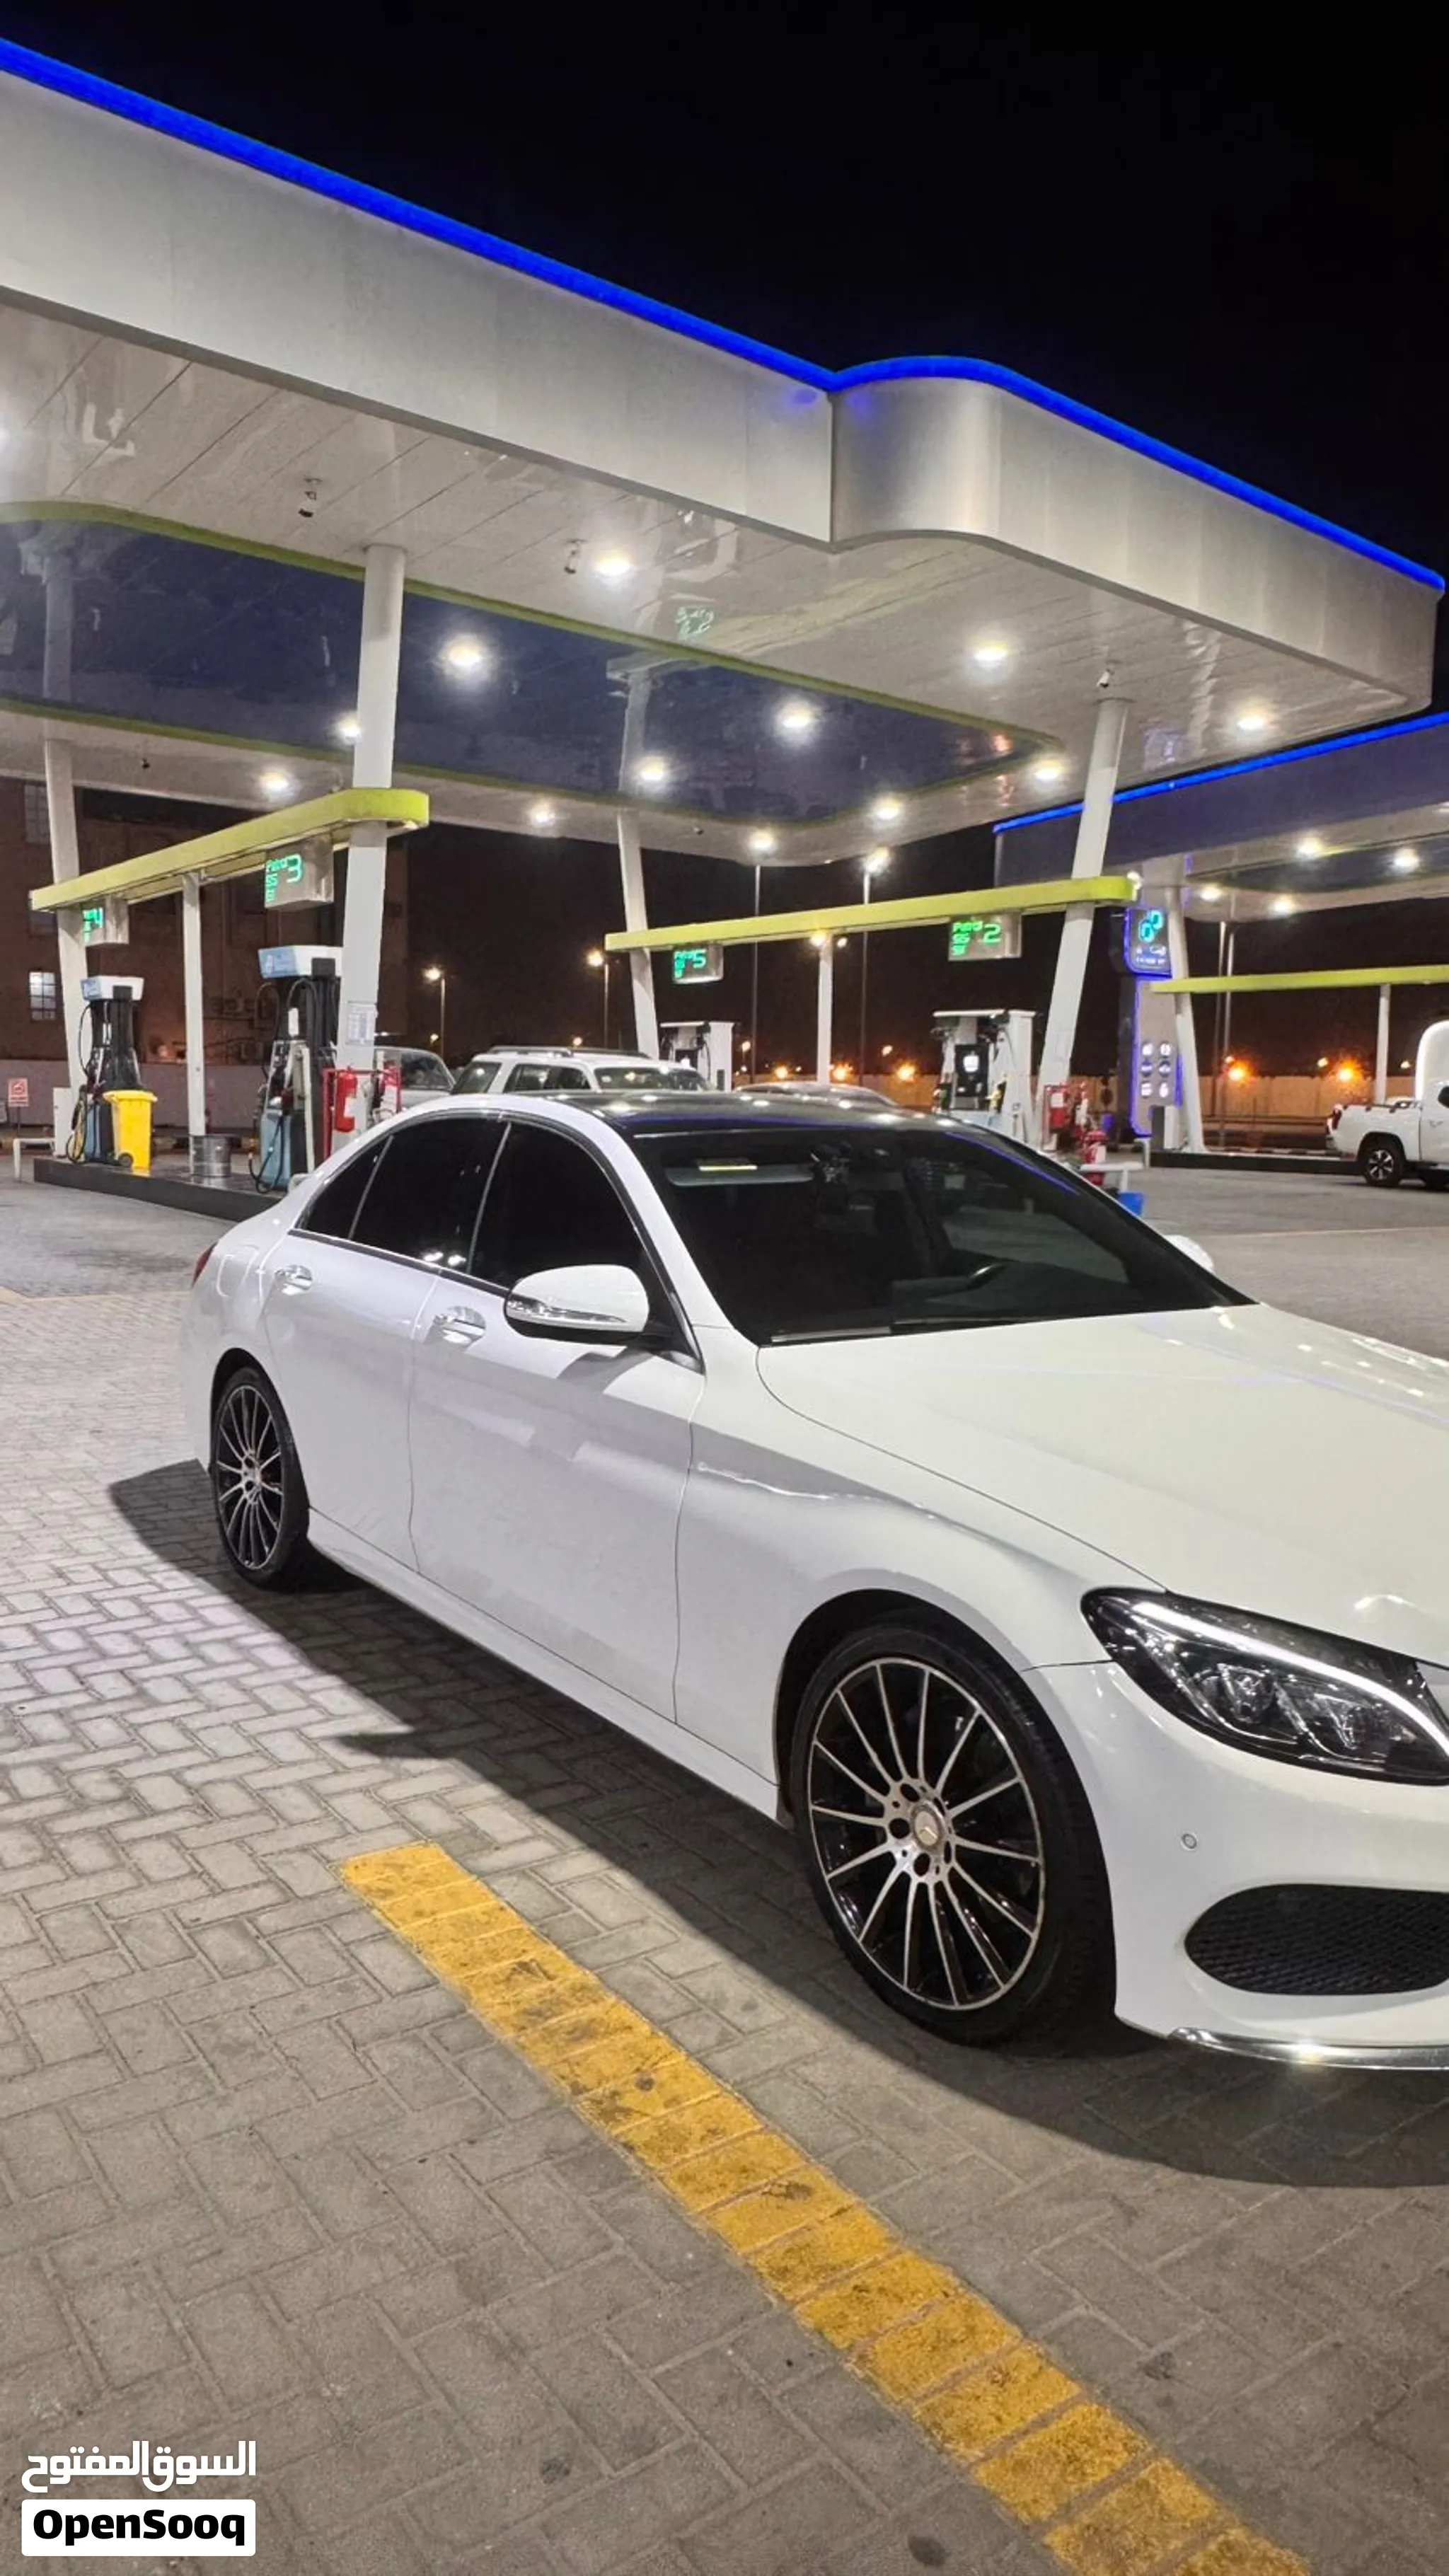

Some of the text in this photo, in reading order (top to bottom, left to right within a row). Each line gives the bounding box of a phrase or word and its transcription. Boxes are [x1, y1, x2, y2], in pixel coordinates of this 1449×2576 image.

[286, 853, 303, 883] 3
[983, 923, 1001, 943] 2
[693, 949, 706, 969] 5
